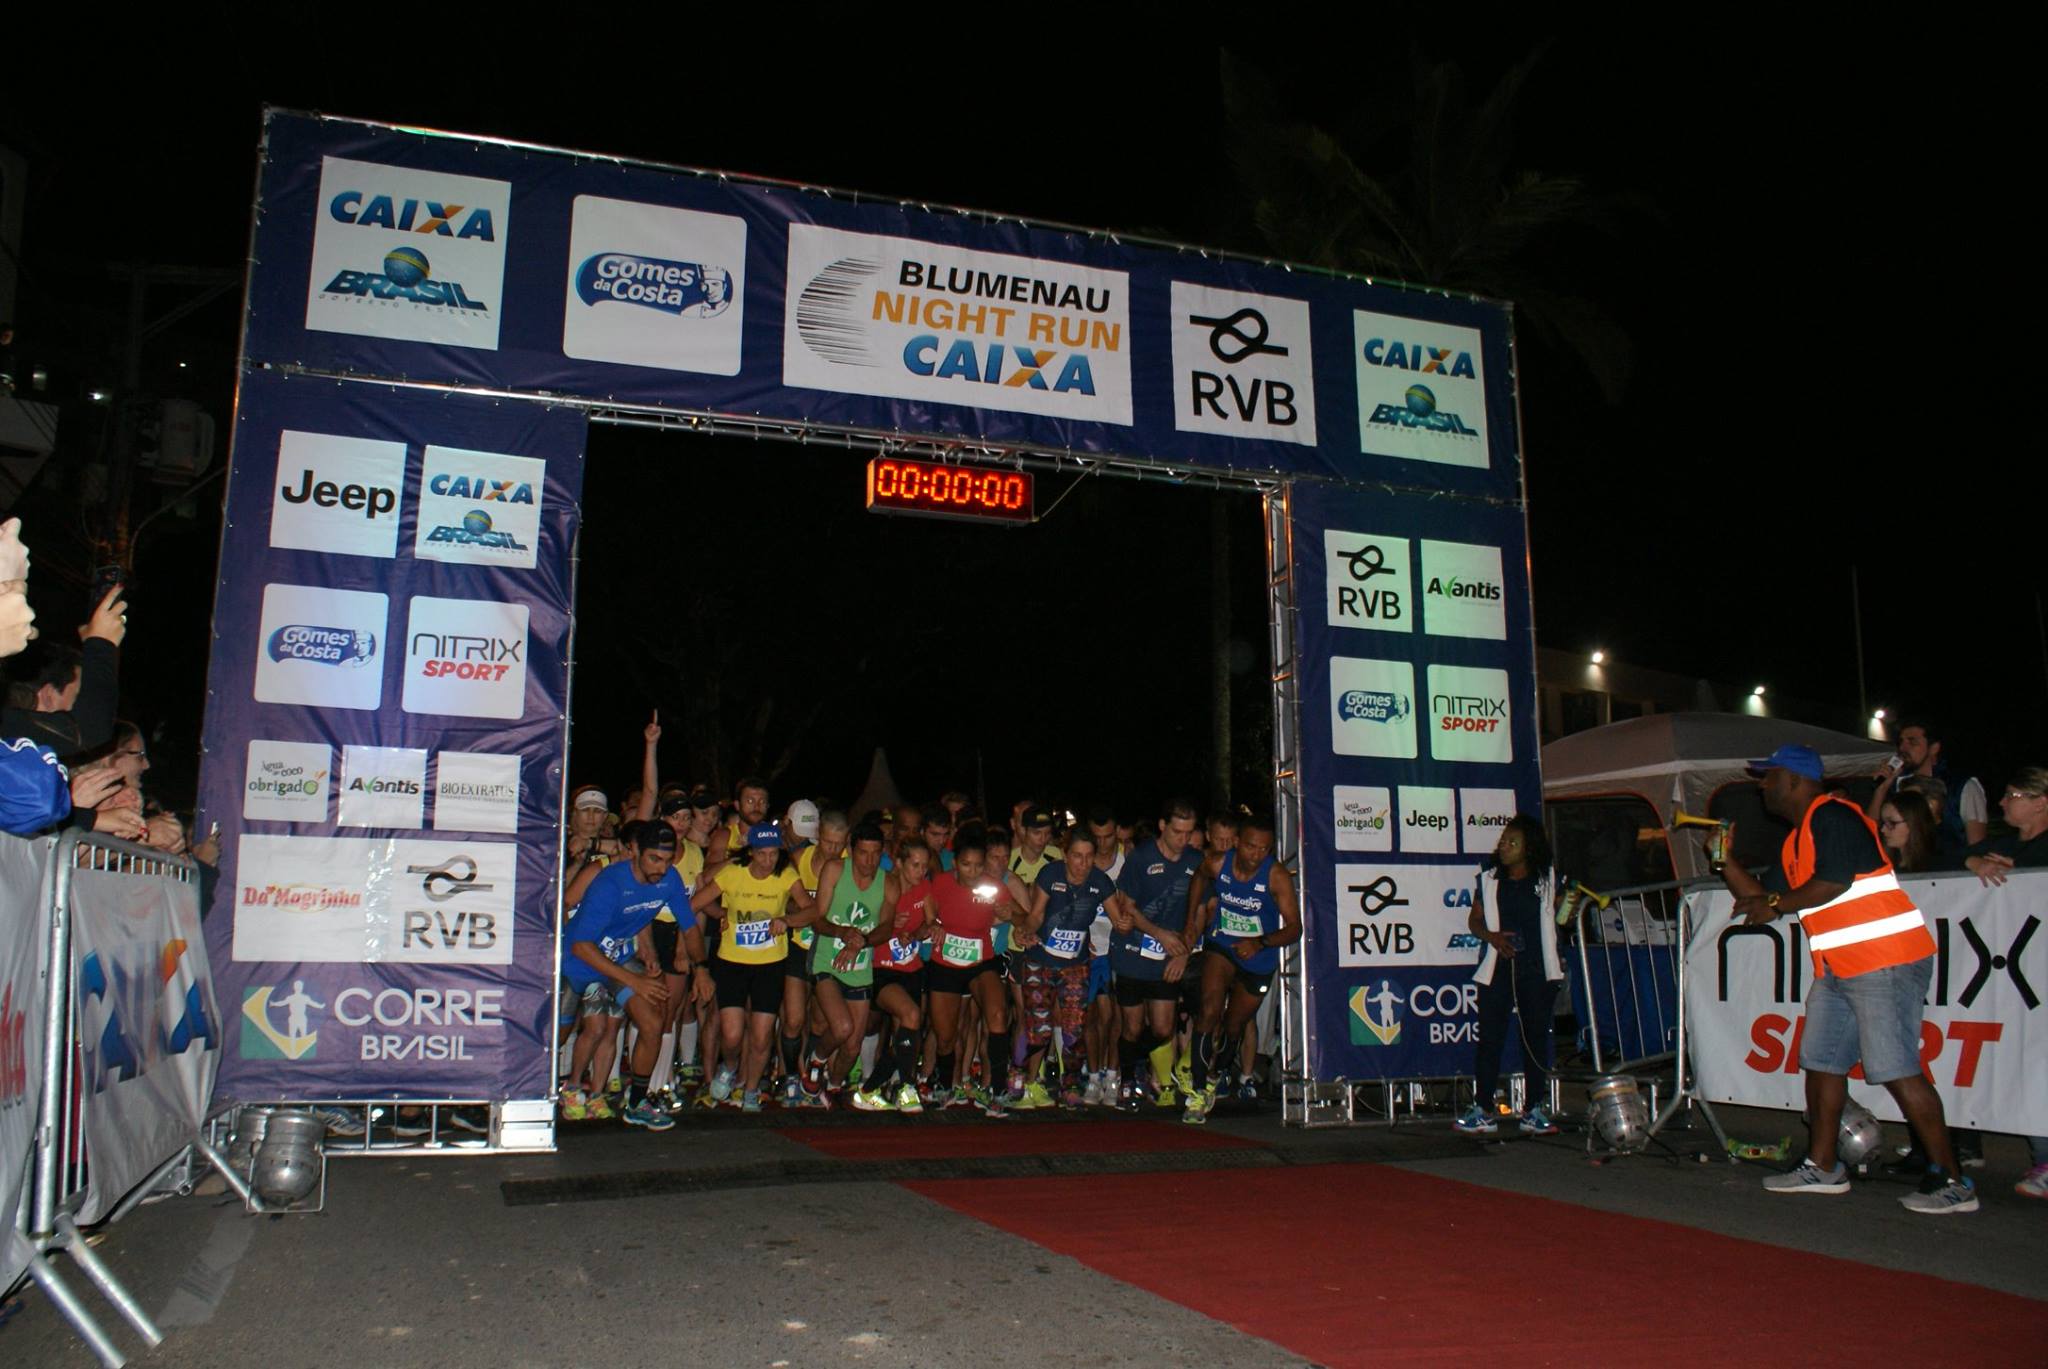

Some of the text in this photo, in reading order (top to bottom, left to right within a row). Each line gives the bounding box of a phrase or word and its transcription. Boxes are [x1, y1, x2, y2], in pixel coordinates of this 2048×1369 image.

[330, 190, 495, 242] CAIXA
[597, 256, 694, 287] Gomes
[323, 269, 488, 311] BRASIL
[593, 278, 683, 306] da Costa
[899, 260, 1110, 313] BLUMENAU
[872, 290, 1121, 352] NIGHT RUN
[903, 335, 1096, 396] CAIXA
[1363, 337, 1476, 380] CAIXA
[1191, 370, 1298, 426] RVB
[1368, 403, 1479, 437] BRASIL
[282, 469, 396, 519] Jeep
[430, 474, 534, 505] CAIXA
[877, 465, 1023, 509] 00:00:00
[426, 525, 528, 551] BRASIL
[1338, 586, 1401, 620] RVB
[1427, 577, 1501, 601] Avantis
[282, 627, 350, 647] Gomes
[291, 642, 342, 660] Costa
[412, 633, 522, 662] NITRIX
[422, 660, 510, 681] SPORT
[1346, 692, 1391, 706] Gomes
[1353, 705, 1387, 718] Costa
[1433, 695, 1506, 717] NITRIX
[1441, 716, 1499, 732] SPORT
[248, 777, 319, 796] obrigado
[349, 777, 419, 795] Avantis
[1337, 816, 1385, 831] obrigado
[1406, 810, 1449, 831] Jeep
[403, 911, 497, 949] RVB
[738, 922, 770, 932] CAIXA
[742, 931, 767, 944] 174
[1350, 923, 1414, 955] RVB
[948, 948, 972, 959] 697
[1054, 939, 1076, 951] 262
[1717, 914, 2041, 1010] NIIX
[334, 988, 505, 1026] CORRE
[1410, 984, 1478, 1017] COR
[361, 1035, 473, 1060] BRASIL
[1430, 1023, 1480, 1044] BRAS
